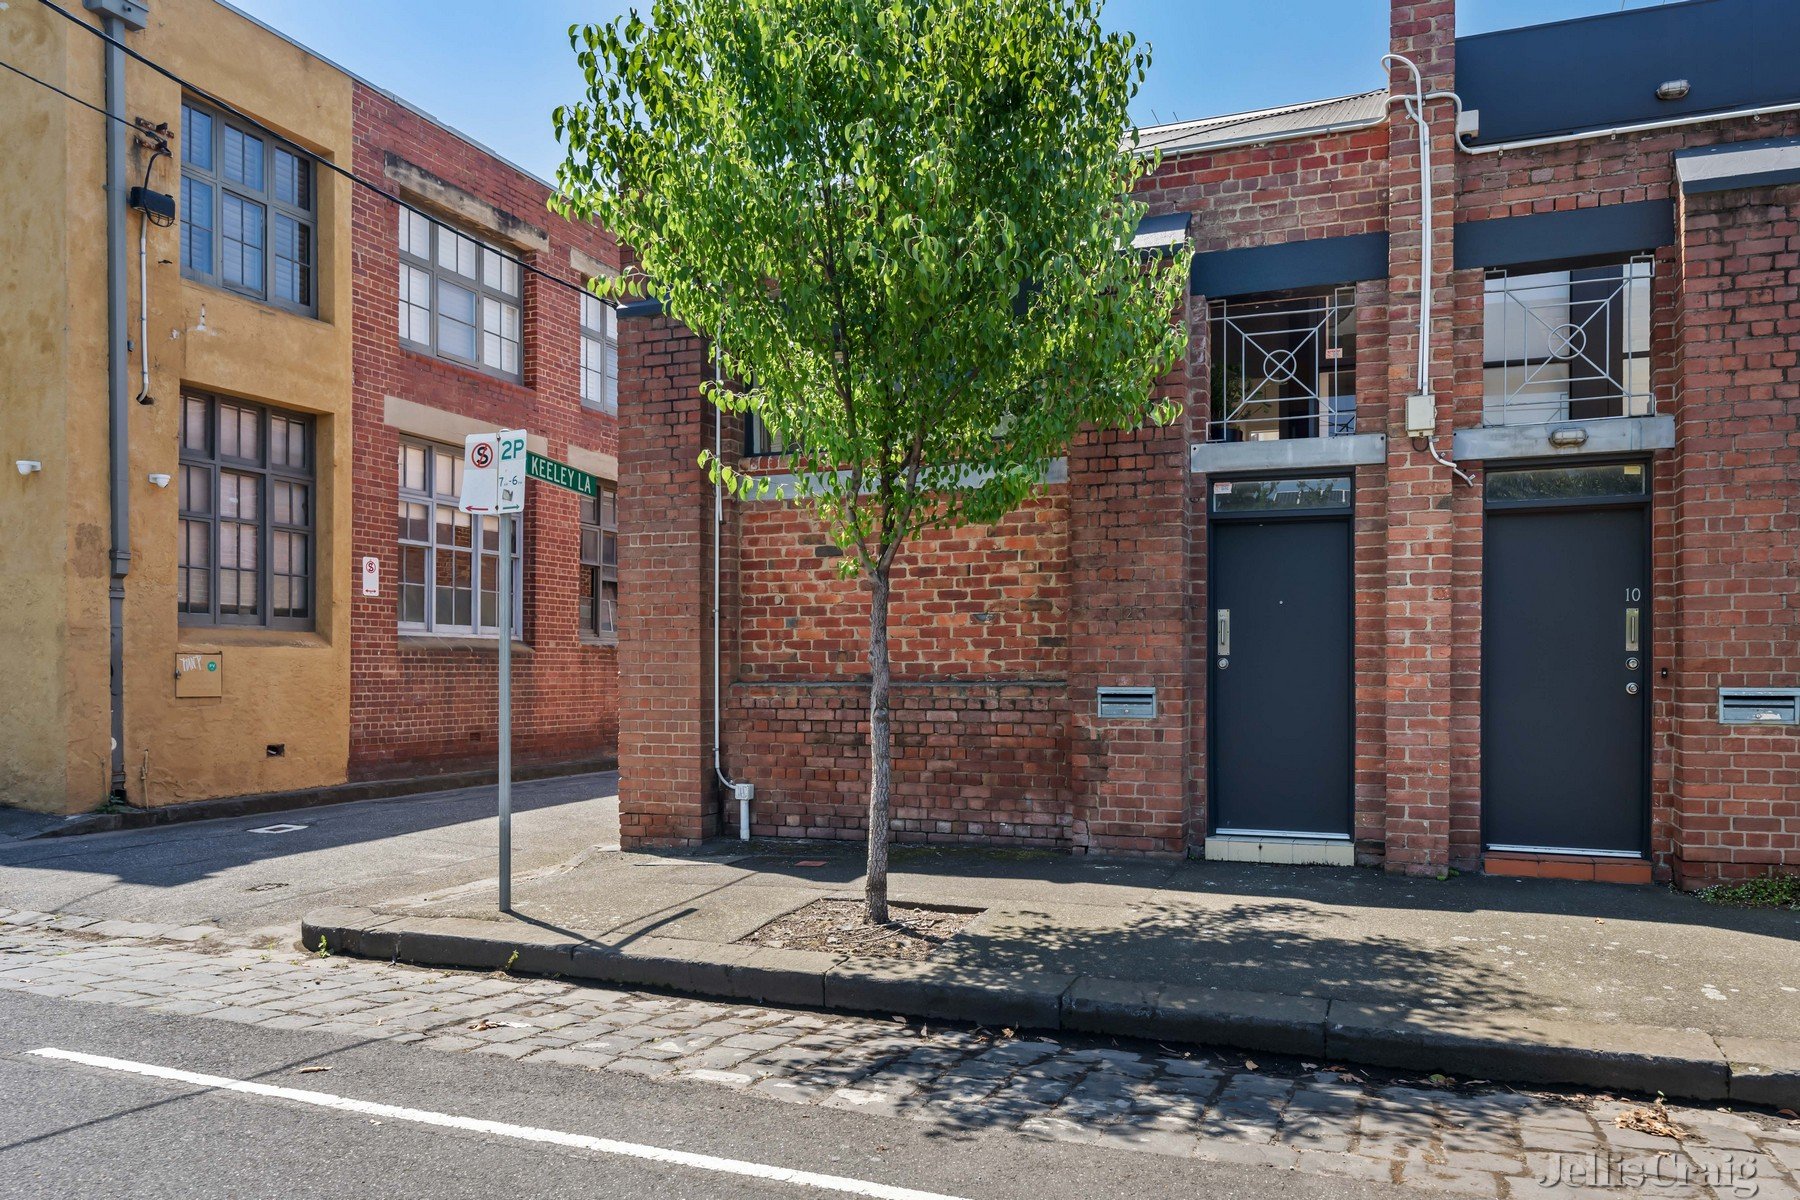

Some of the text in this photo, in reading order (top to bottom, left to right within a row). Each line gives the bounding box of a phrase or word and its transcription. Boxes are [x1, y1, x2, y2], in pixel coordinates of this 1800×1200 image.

[501, 438, 525, 460] 2P
[531, 455, 592, 495] KEELEY LA
[1625, 587, 1641, 602] 10
